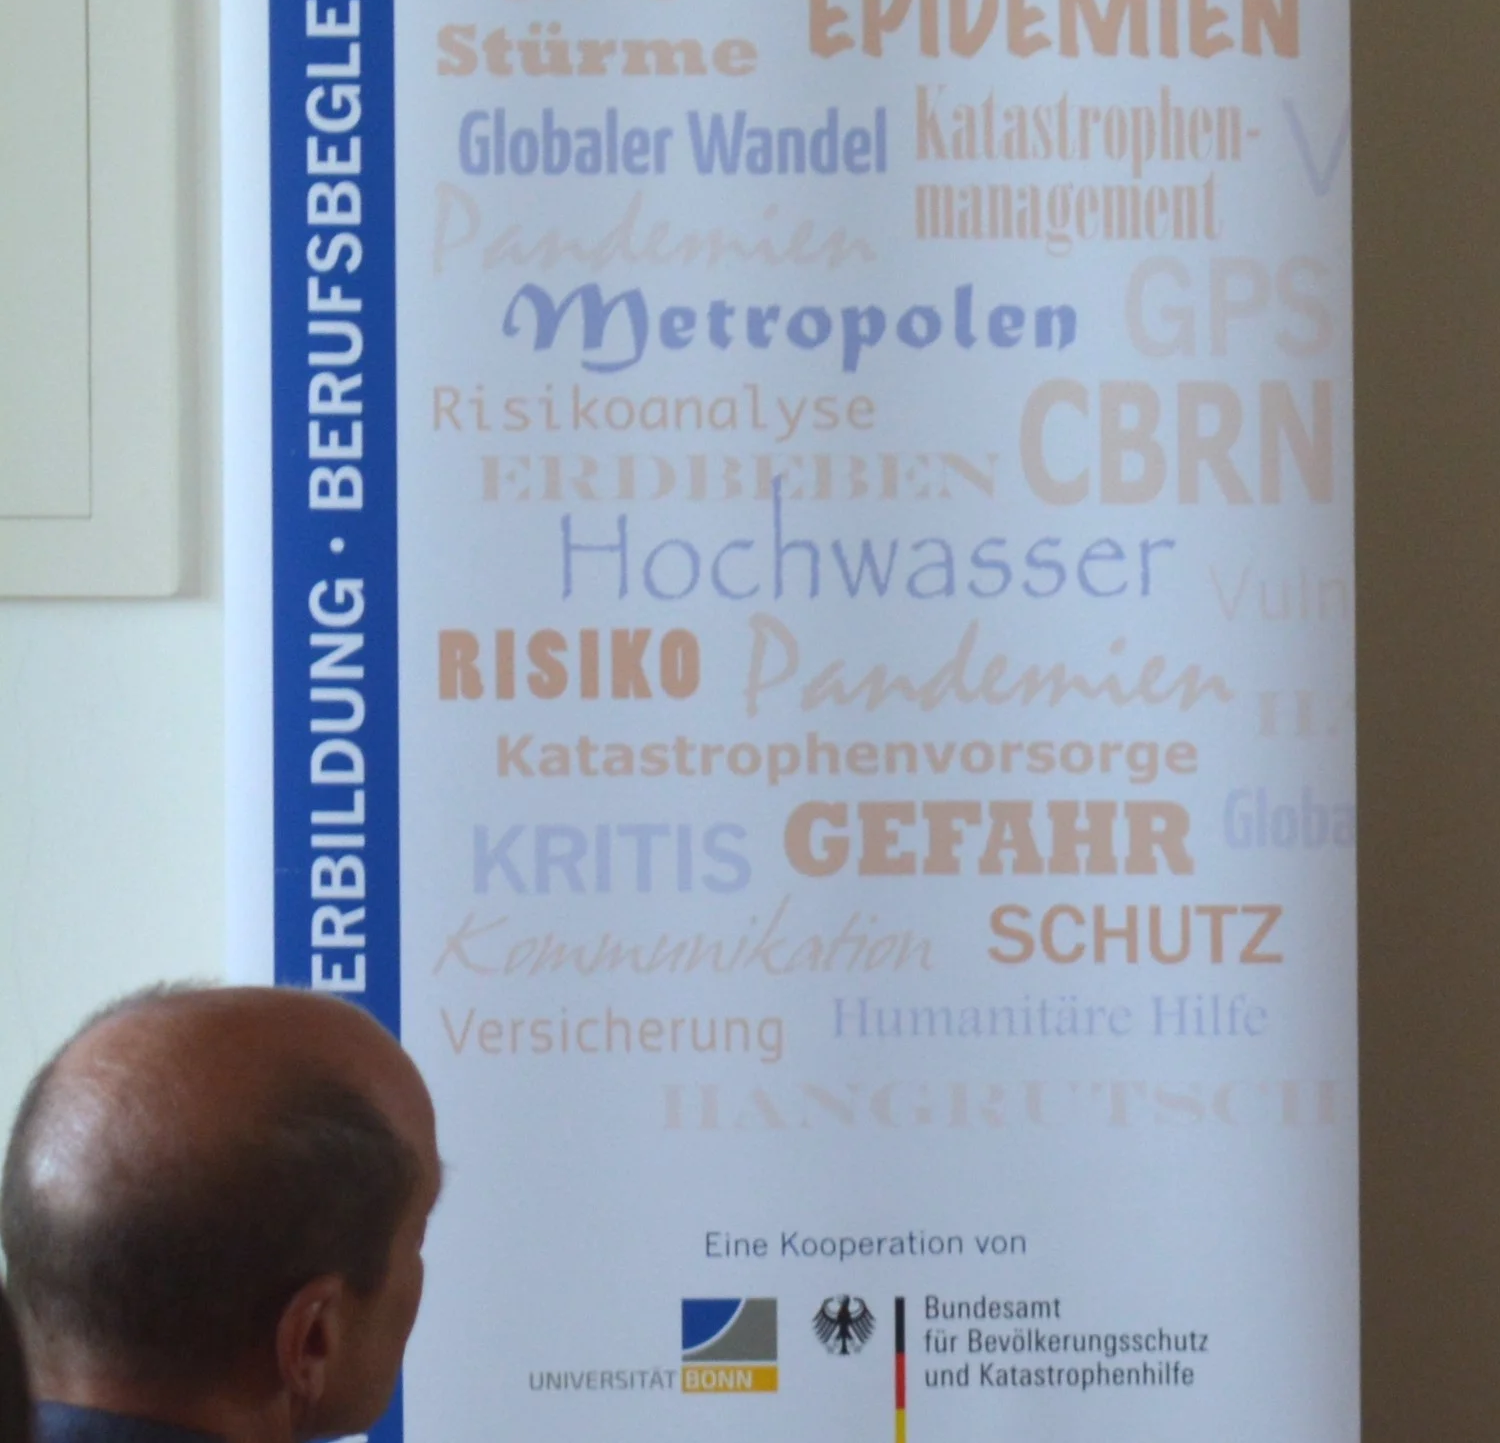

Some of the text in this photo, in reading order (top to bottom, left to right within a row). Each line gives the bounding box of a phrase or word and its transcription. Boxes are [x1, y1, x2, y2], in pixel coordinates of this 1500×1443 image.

[436, 21, 758, 76] Stürme
[459, 108, 887, 176] Globaler Wandel
[915, 83, 1260, 178] Katastrophen-
[431, 181, 876, 274] Pandemien
[915, 172, 1223, 257] management
[501, 284, 1077, 373] Metropolen
[1125, 256, 1332, 359] GPS
[432, 384, 875, 441] Risikoanalyse
[1019, 378, 1332, 504] CBRN
[480, 453, 997, 500] ERDBEBEN
[560, 474, 1175, 599] Hochwasser
[438, 629, 700, 700] RISIKO
[744, 614, 1231, 716] Pandemien
[495, 732, 1197, 785] Katastrophenvorsorge
[472, 823, 750, 895] KRITIS
[783, 801, 1193, 876] GEFAHR
[432, 895, 933, 977] Kommunikation
[987, 905, 1284, 965] SCHUTZ
[441, 1008, 785, 1063] Versicherung
[832, 995, 1268, 1039] Humanitäre Hilfe
[705, 1231, 1027, 1261] Eine Kooperation von
[924, 1295, 1061, 1319] Bundesamt
[529, 1366, 752, 1390] UNIVERSITÄT BONN
[924, 1328, 1209, 1360] für Bevölkerungsschutz
[924, 1361, 1194, 1394] und Katastrophenhilfe
